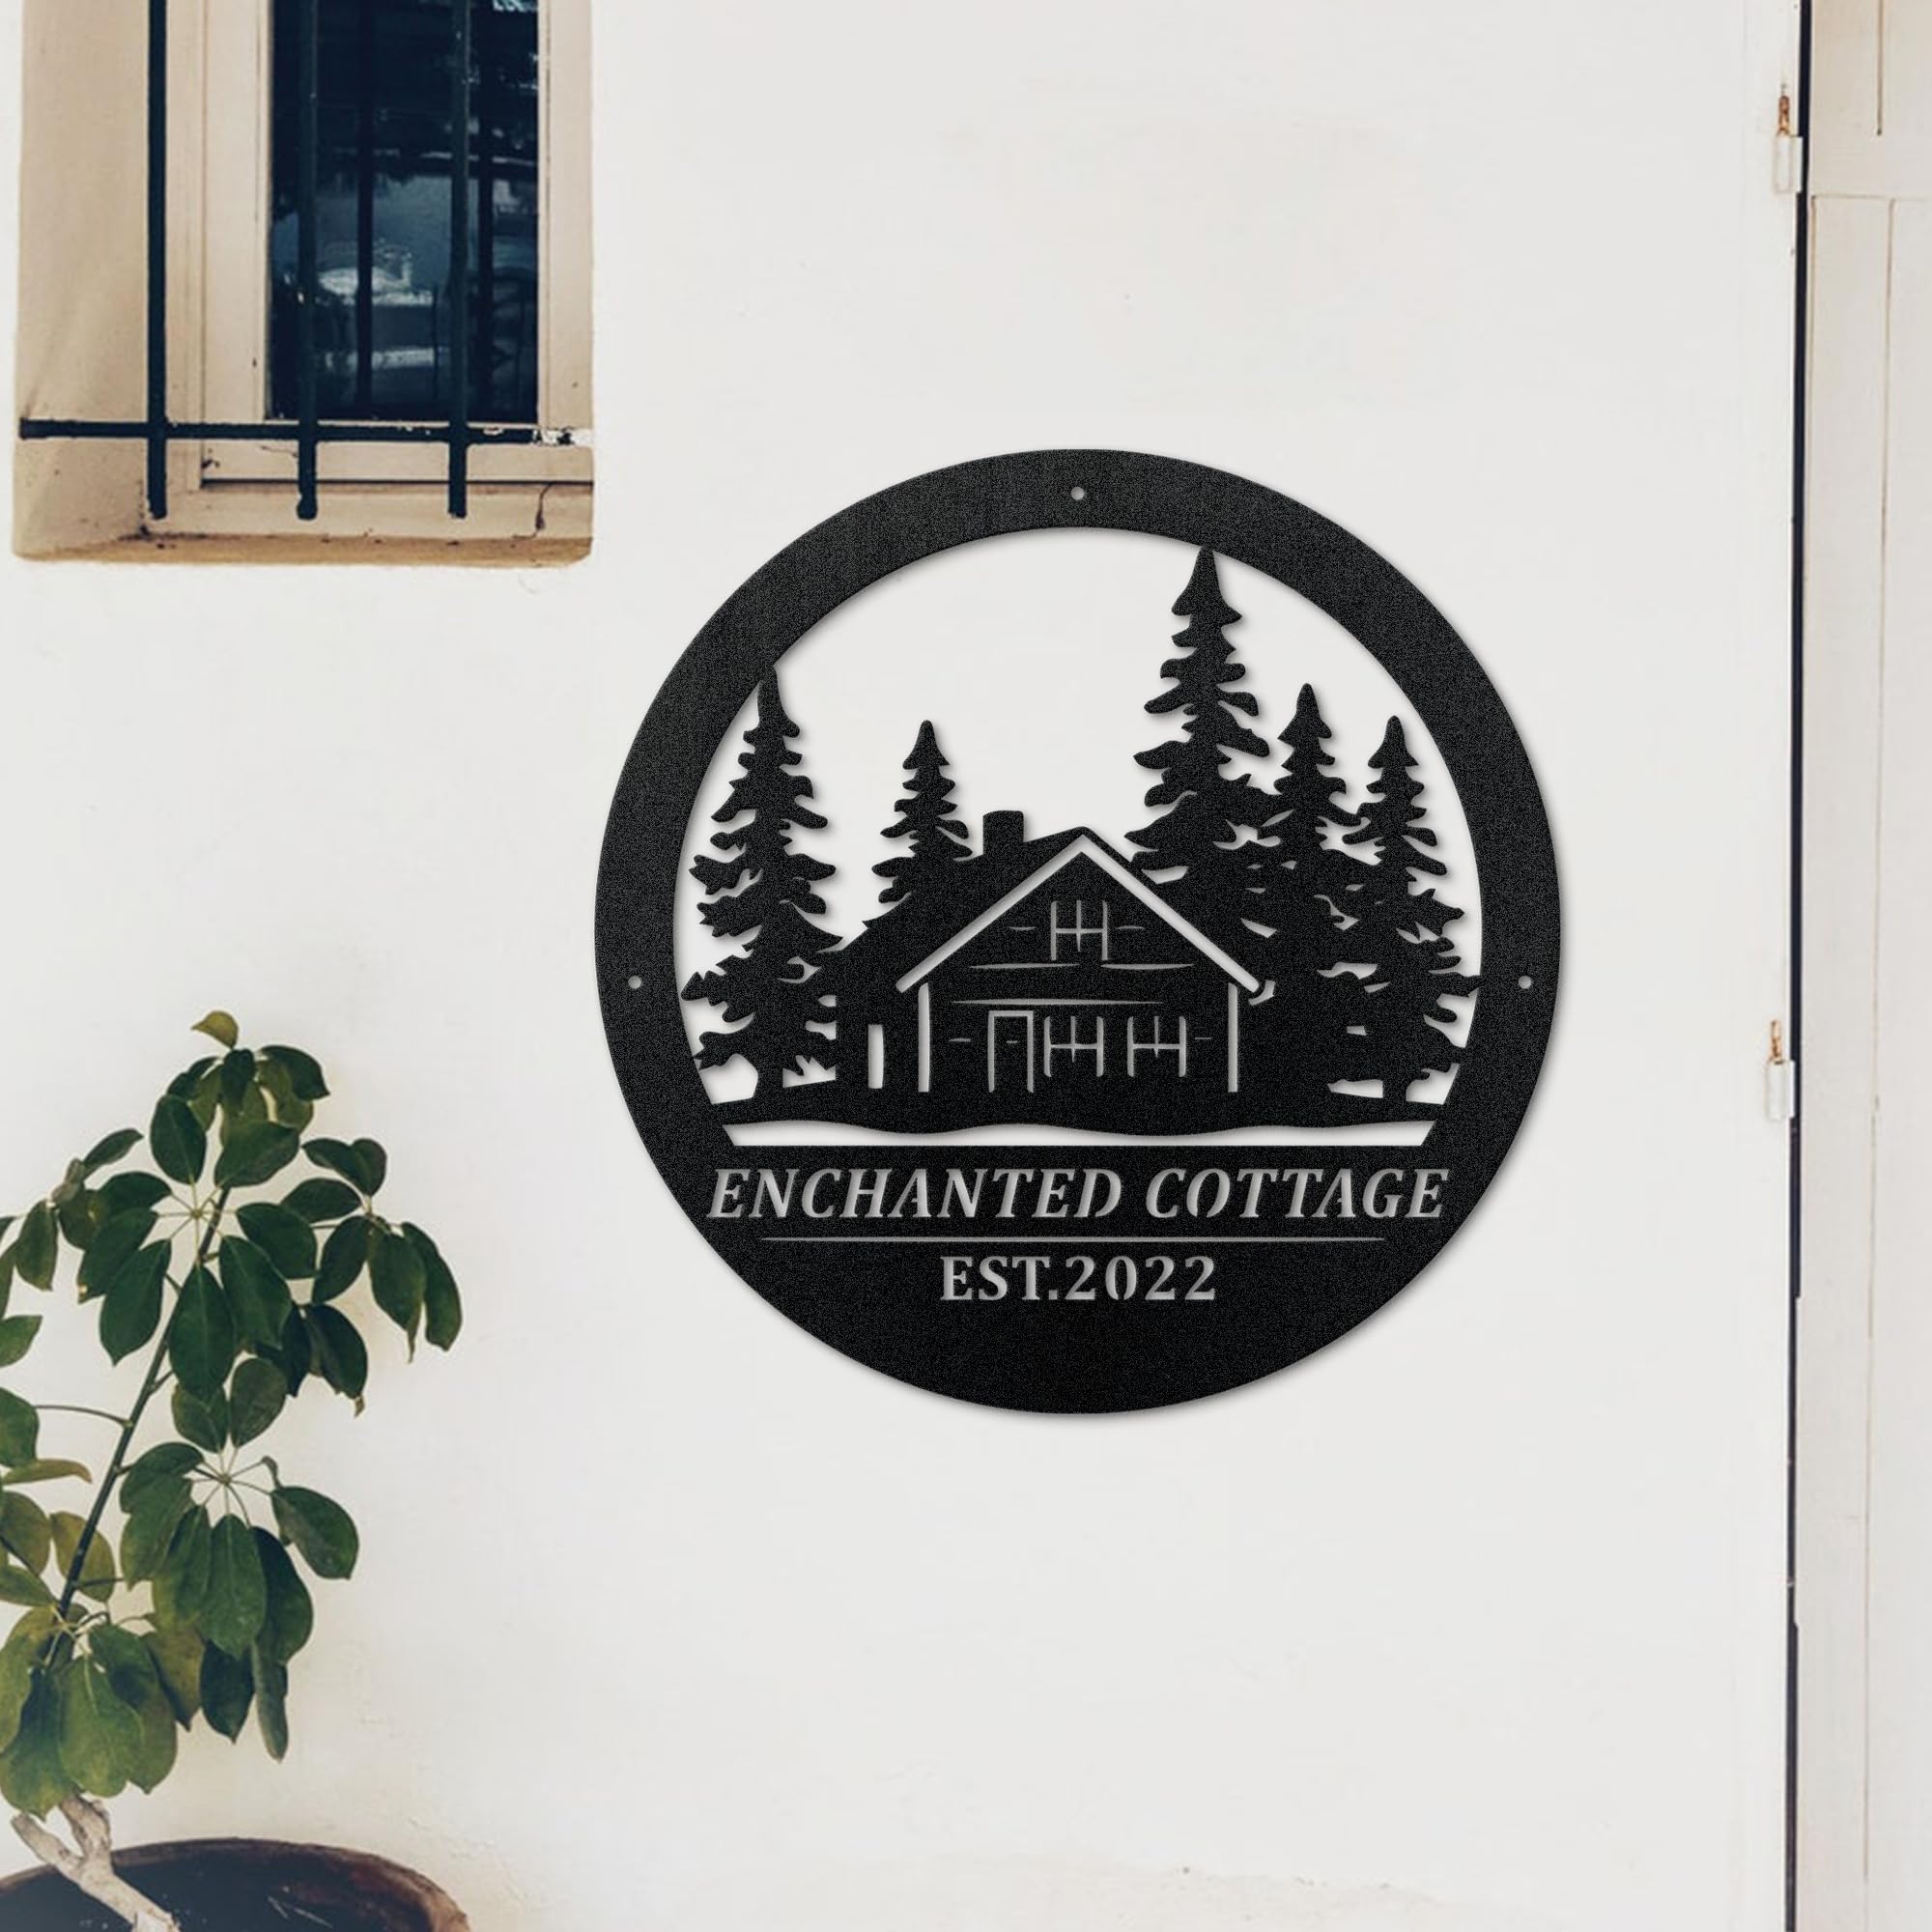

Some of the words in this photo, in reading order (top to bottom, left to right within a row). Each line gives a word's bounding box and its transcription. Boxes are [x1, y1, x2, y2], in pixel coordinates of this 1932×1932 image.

[706, 1168, 1122, 1219] ENCHANTED
[1146, 1168, 1451, 1219] COTTAGE
[940, 1256, 1216, 1301] EST.2022
